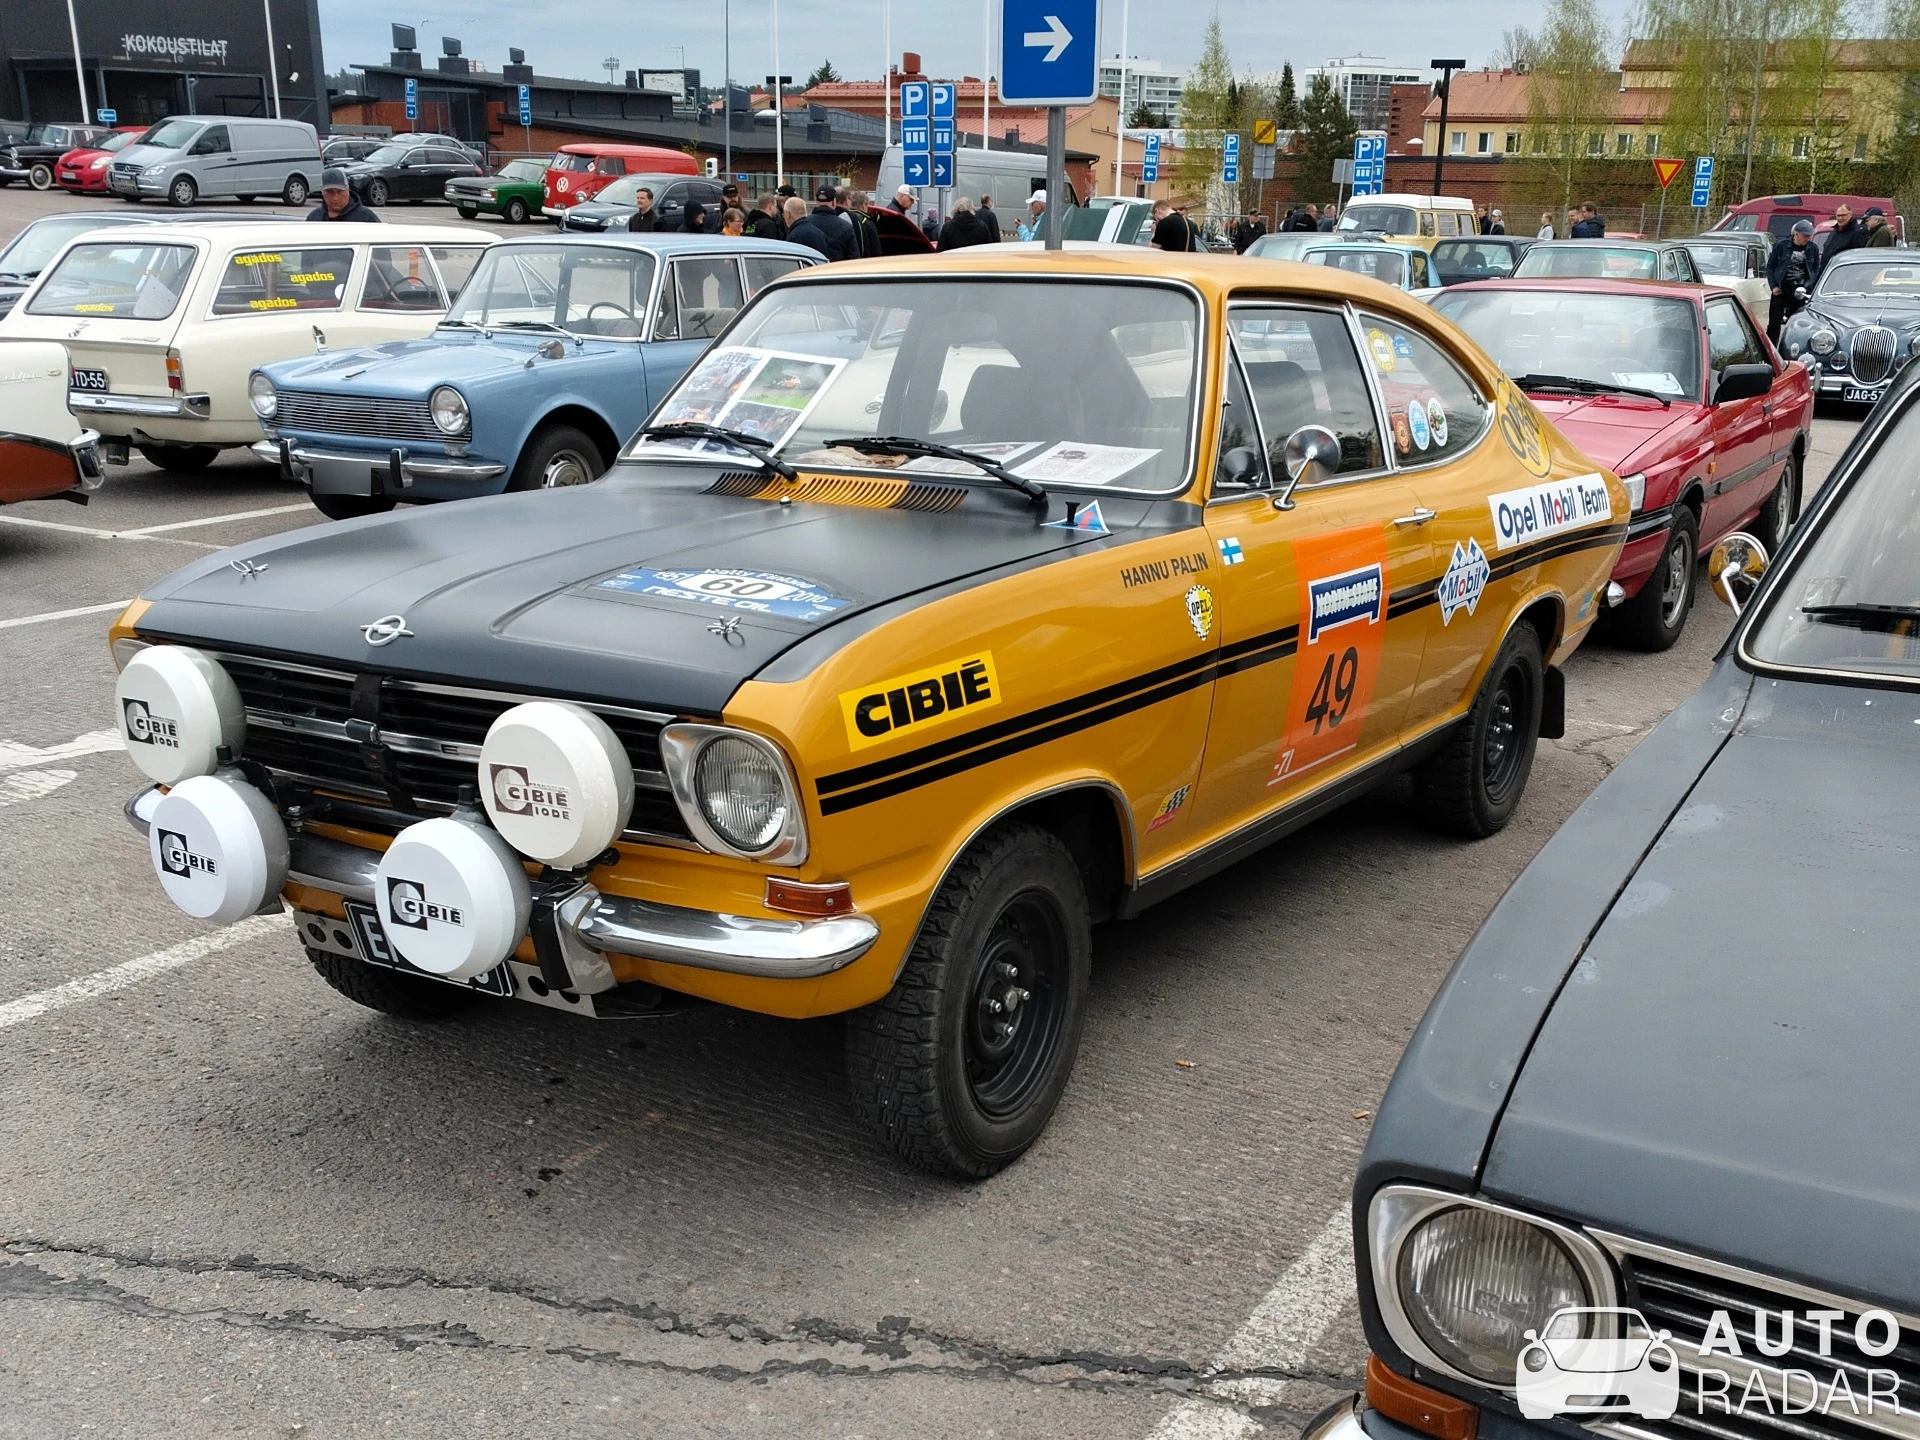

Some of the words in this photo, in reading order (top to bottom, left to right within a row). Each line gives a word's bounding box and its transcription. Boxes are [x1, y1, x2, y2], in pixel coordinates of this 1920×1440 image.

[125, 34, 227, 57] KOKOUSTILAT
[407, 81, 414, 92] P
[520, 86, 527, 97] P
[905, 85, 924, 115] P
[933, 87, 948, 116] P
[1147, 136, 1157, 149] P
[1227, 136, 1236, 149] P
[1358, 140, 1371, 159] P
[1699, 158, 1710, 173] P
[234, 252, 282, 266] agados
[290, 271, 335, 285] agados
[74, 303, 115, 313] agados
[250, 297, 297, 310] agados
[1498, 496, 1538, 544] Opel
[1540, 487, 1577, 528] Mobil
[1577, 485, 1608, 517] Team
[704, 568, 755, 577] Rally
[1120, 560, 1170, 588] HANNU
[1170, 552, 1209, 577] PALIN
[700, 578, 774, 596] 60
[1447, 566, 1481, 602] Mobil
[1191, 598, 1210, 616] OPEL
[1304, 646, 1358, 735] 49
[155, 735, 179, 748] IODE
[535, 806, 570, 820] IODE
